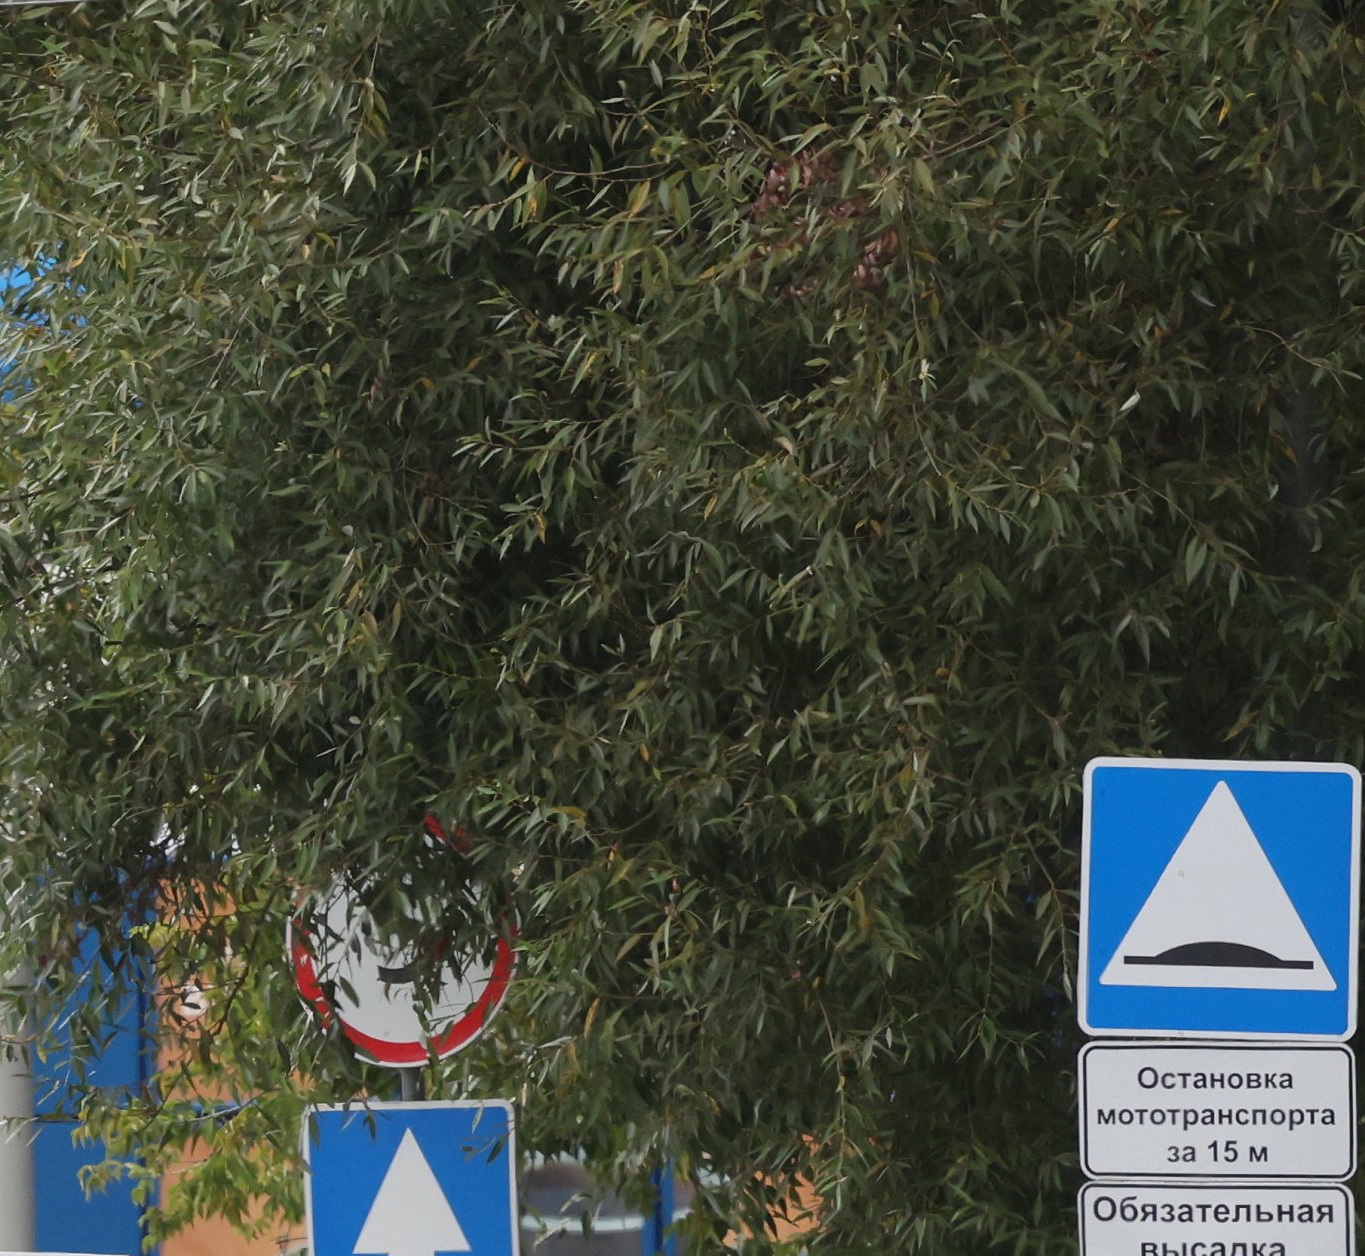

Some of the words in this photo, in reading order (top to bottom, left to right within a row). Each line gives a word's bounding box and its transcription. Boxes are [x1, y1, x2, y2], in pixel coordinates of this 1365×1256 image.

[1137, 1065, 1294, 1090] Остановка
[1096, 1107, 1335, 1131] мототранспорта
[1166, 1144, 1197, 1163] за
[1208, 1139, 1239, 1163] 15
[1249, 1144, 1269, 1162] м
[1093, 1195, 1334, 1224] Обязательная
